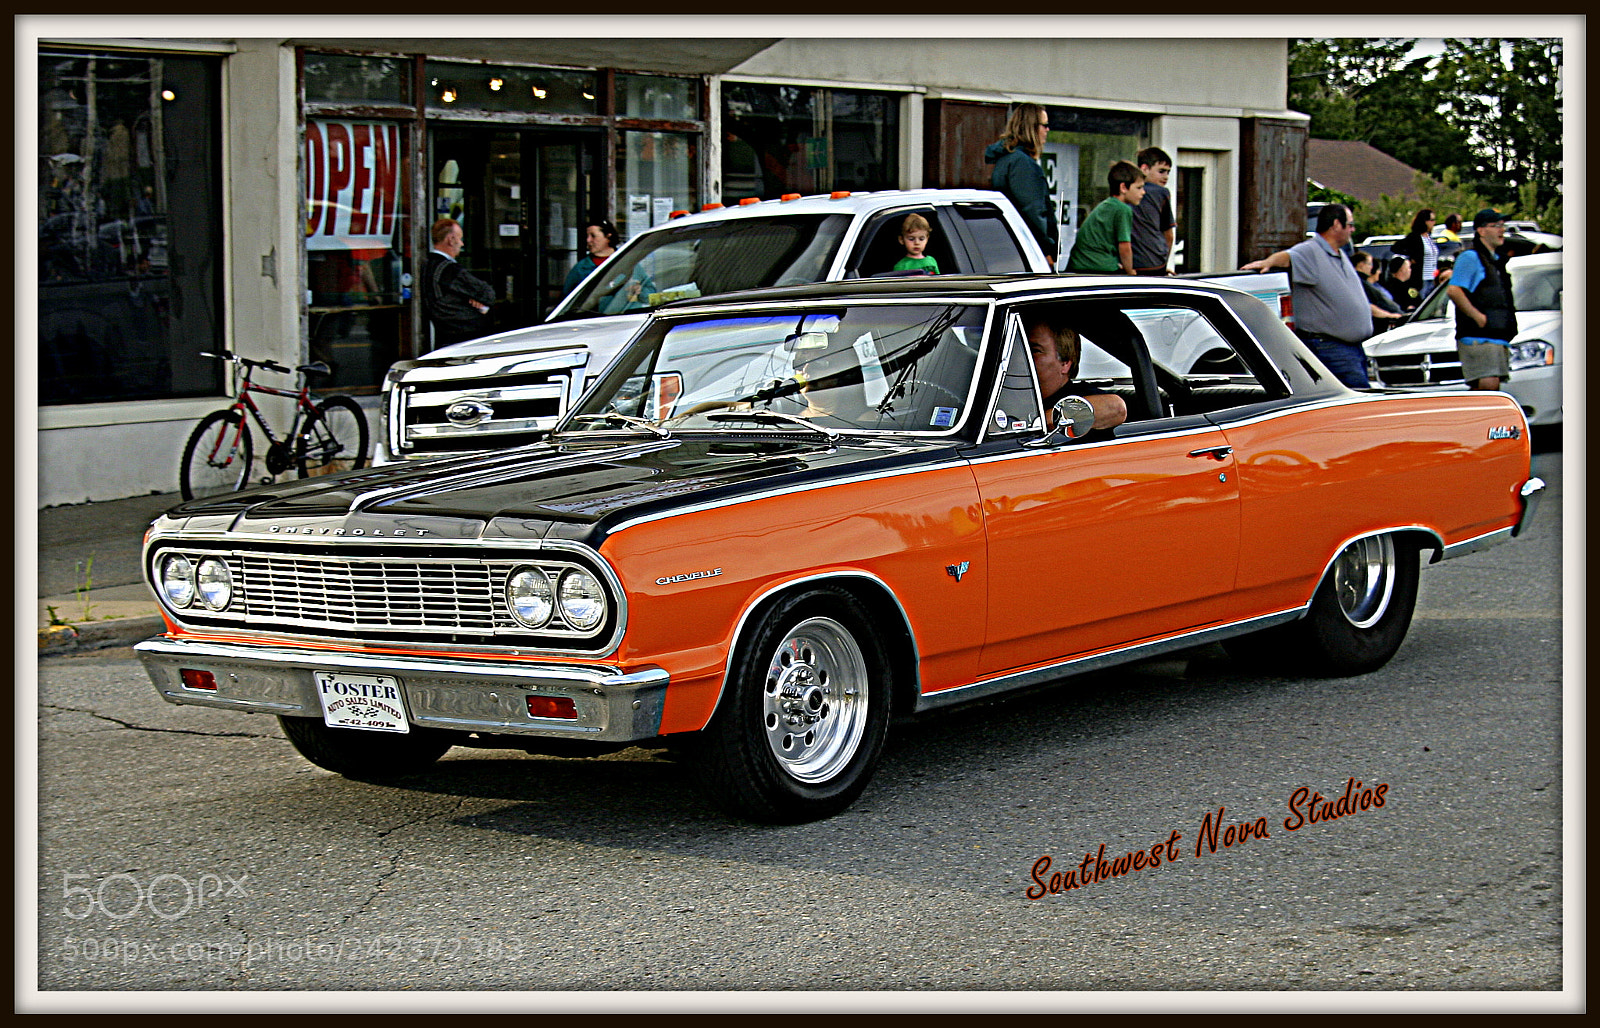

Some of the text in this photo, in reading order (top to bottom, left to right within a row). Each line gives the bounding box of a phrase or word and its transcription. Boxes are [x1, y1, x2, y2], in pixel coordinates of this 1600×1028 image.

[306, 119, 397, 237] OPEN
[269, 525, 429, 536] CHEVROLET
[655, 567, 723, 585] CHEVELLE
[321, 679, 397, 699] FOSTER
[327, 697, 402, 720] AUTO SALES LIMITED
